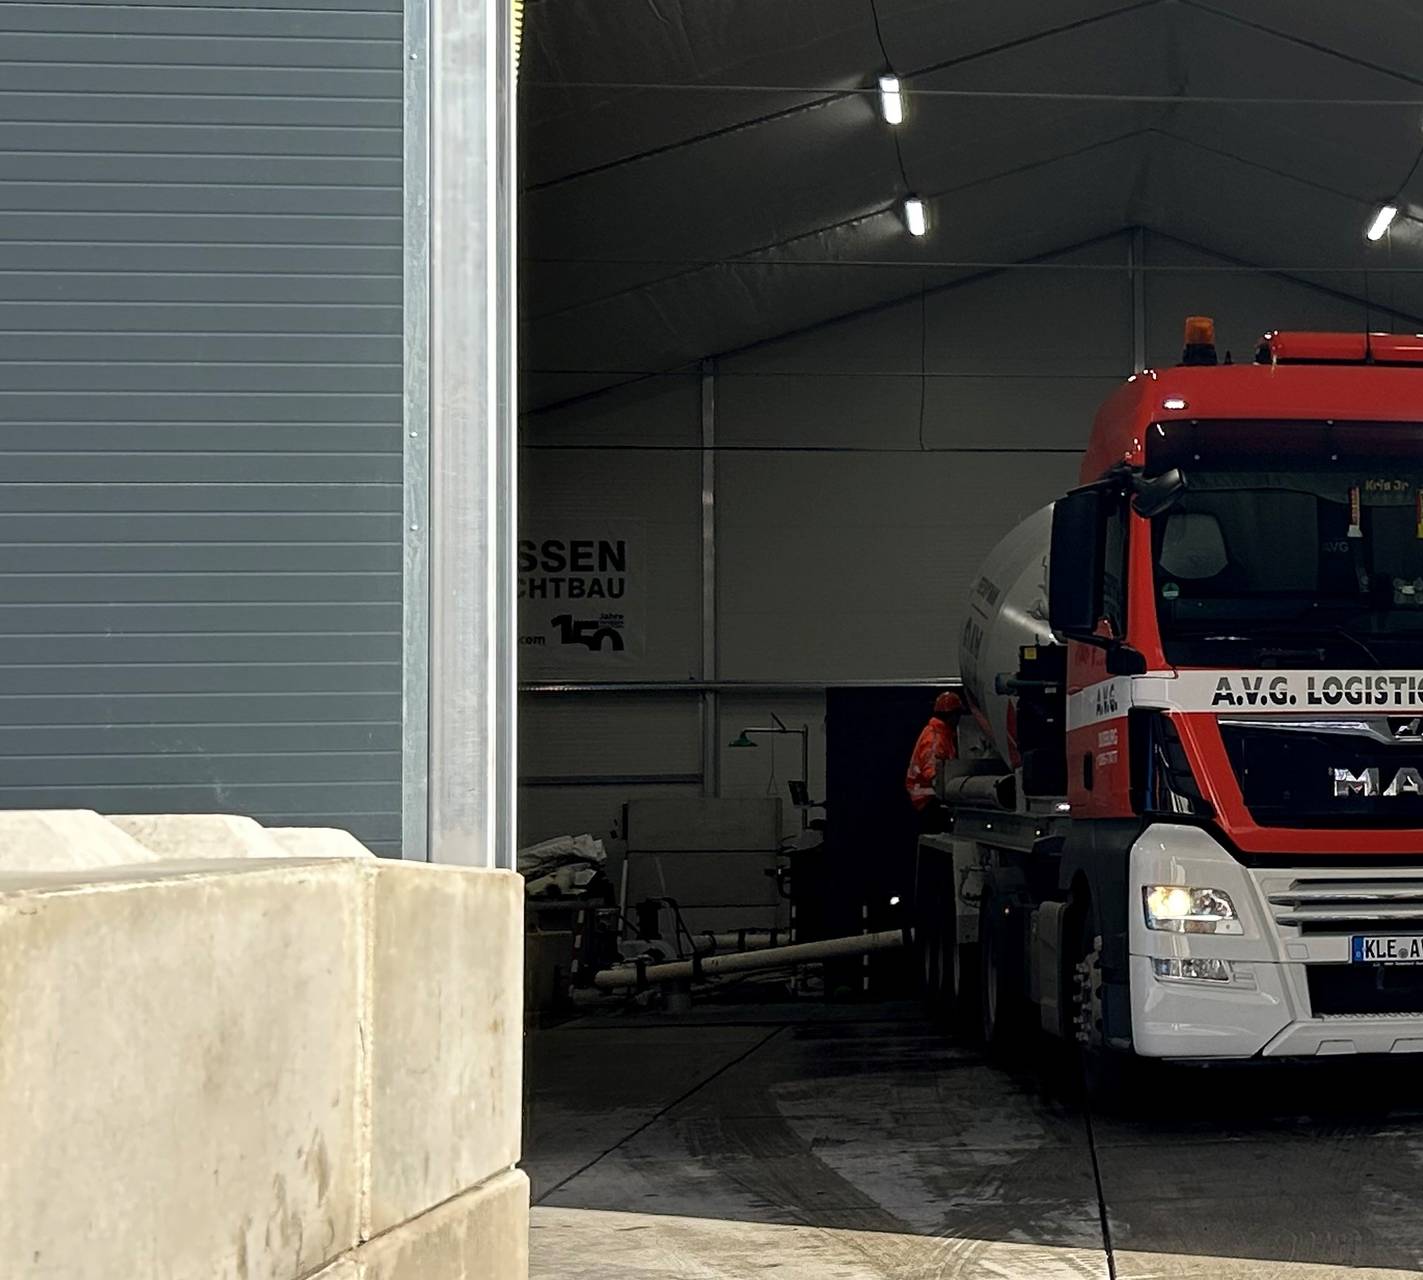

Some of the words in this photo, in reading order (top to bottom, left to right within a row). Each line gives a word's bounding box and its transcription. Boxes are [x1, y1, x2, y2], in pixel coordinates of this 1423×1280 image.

[517, 540, 625, 572] SSEN
[1212, 676, 1296, 705] A.V.G.
[1365, 939, 1397, 958] KLE
